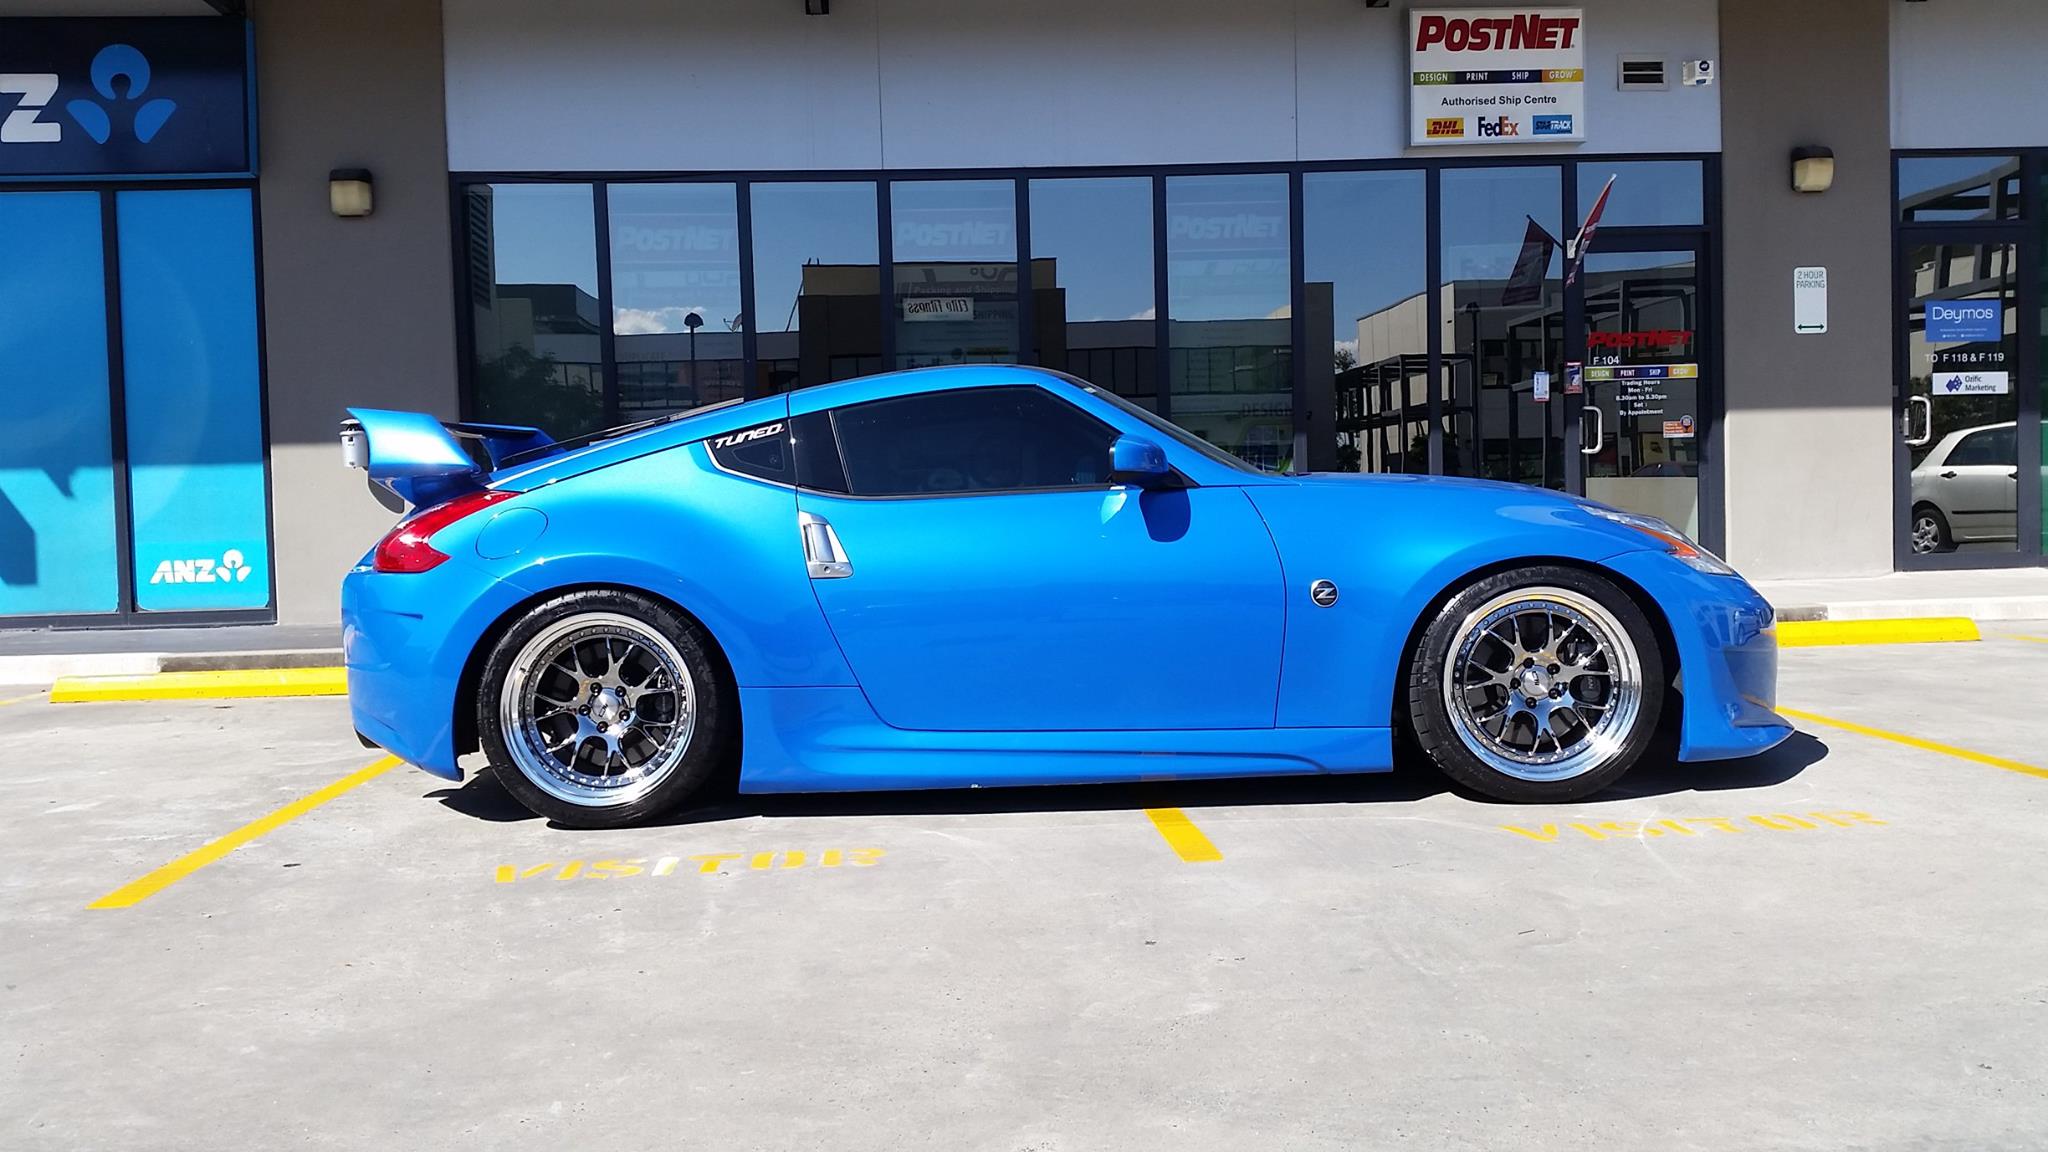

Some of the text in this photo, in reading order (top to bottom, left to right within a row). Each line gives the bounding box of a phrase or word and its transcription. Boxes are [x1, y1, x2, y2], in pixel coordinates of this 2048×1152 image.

[1416, 14, 1579, 51] POSTNET
[1420, 72, 1448, 82] DESIGN
[1466, 71, 1488, 81] PRINT
[1511, 71, 1529, 81] SHIP
[1441, 95, 1557, 106] Authorised Ship Centre
[1430, 120, 1462, 135] DHL
[1478, 116, 1519, 137] FedEx
[895, 220, 1011, 247] POSTNET
[1171, 213, 1283, 240] POSTNET
[617, 225, 734, 251] POSTNET
[1797, 271, 1824, 279] 2 HOUR
[1796, 280, 1825, 289] PARKING
[1932, 307, 1993, 324] Deymos
[1587, 331, 1692, 348] POSTNET
[1593, 356, 1600, 365] F
[1602, 355, 1620, 365] 104
[1925, 353, 2004, 363] TO F 118 & F 119
[1965, 384, 1996, 392] Marketing
[1627, 408, 1664, 416] Appointment
[150, 559, 216, 584] ANZ
[1499, 810, 1888, 842] VISITOR
[495, 847, 888, 883] VISITOR
